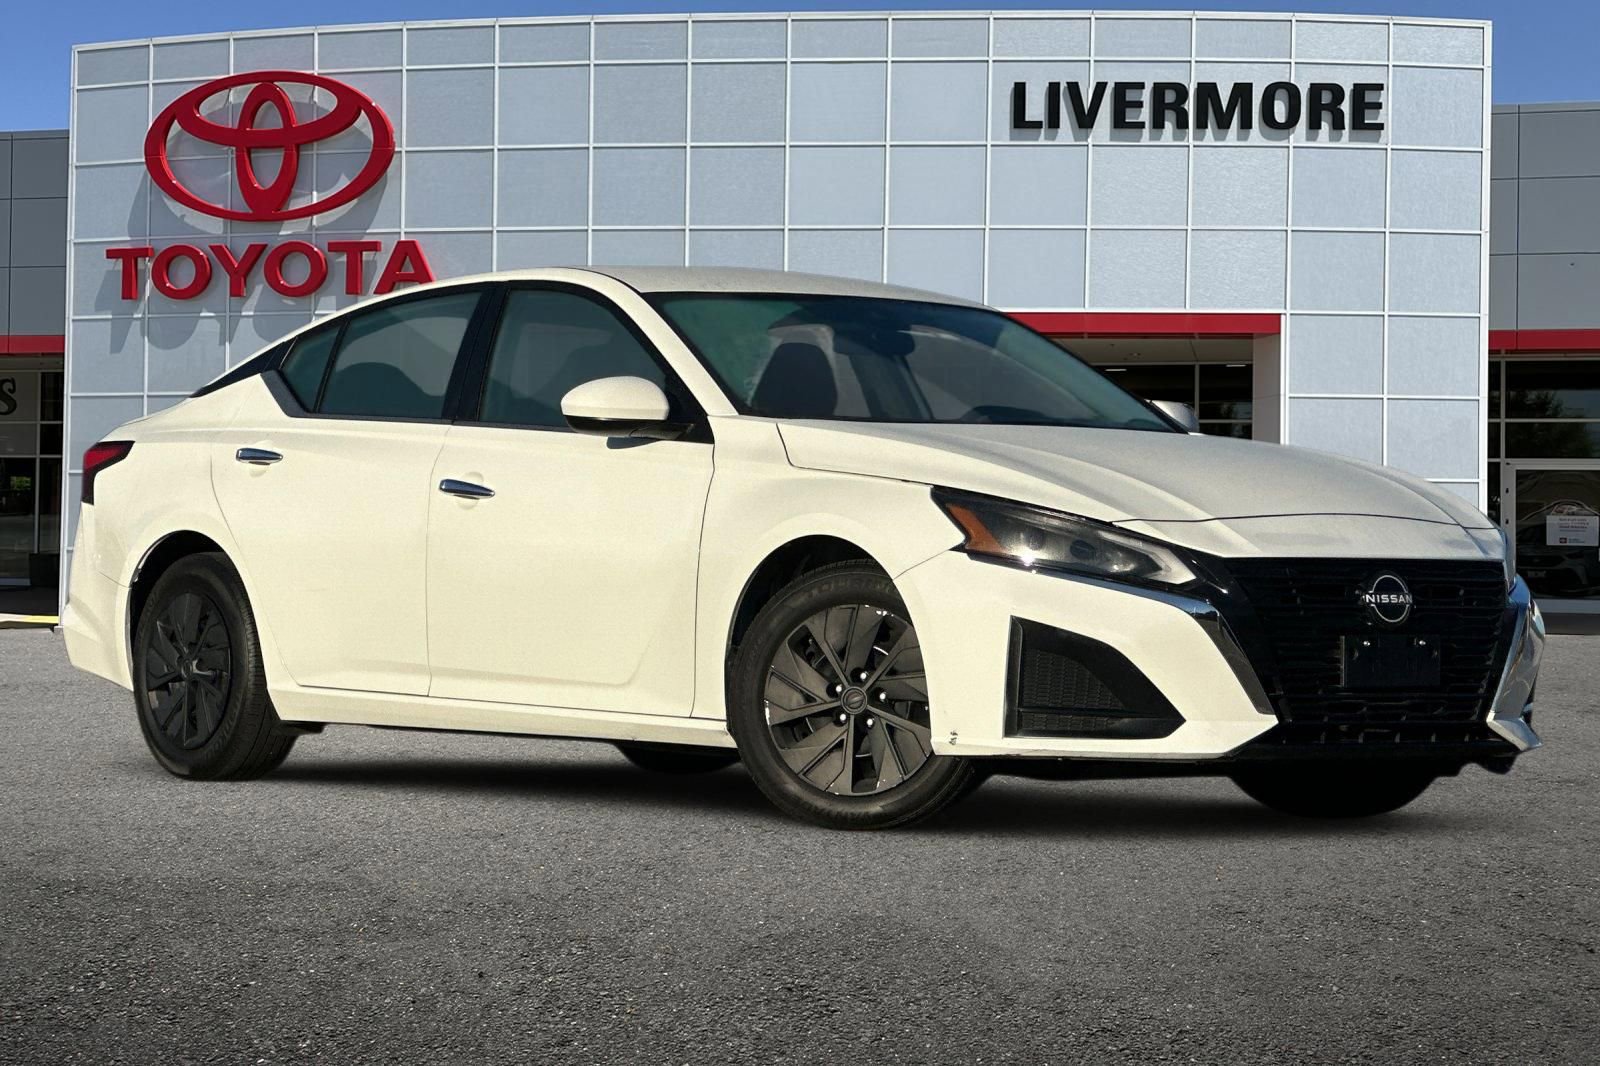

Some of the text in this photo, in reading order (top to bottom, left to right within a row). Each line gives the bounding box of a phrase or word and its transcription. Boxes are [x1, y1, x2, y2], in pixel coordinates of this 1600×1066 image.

[1013, 81, 1385, 131] LIVERMORE
[106, 240, 435, 300] TOYOTA
[1365, 594, 1413, 604] NISSAN
